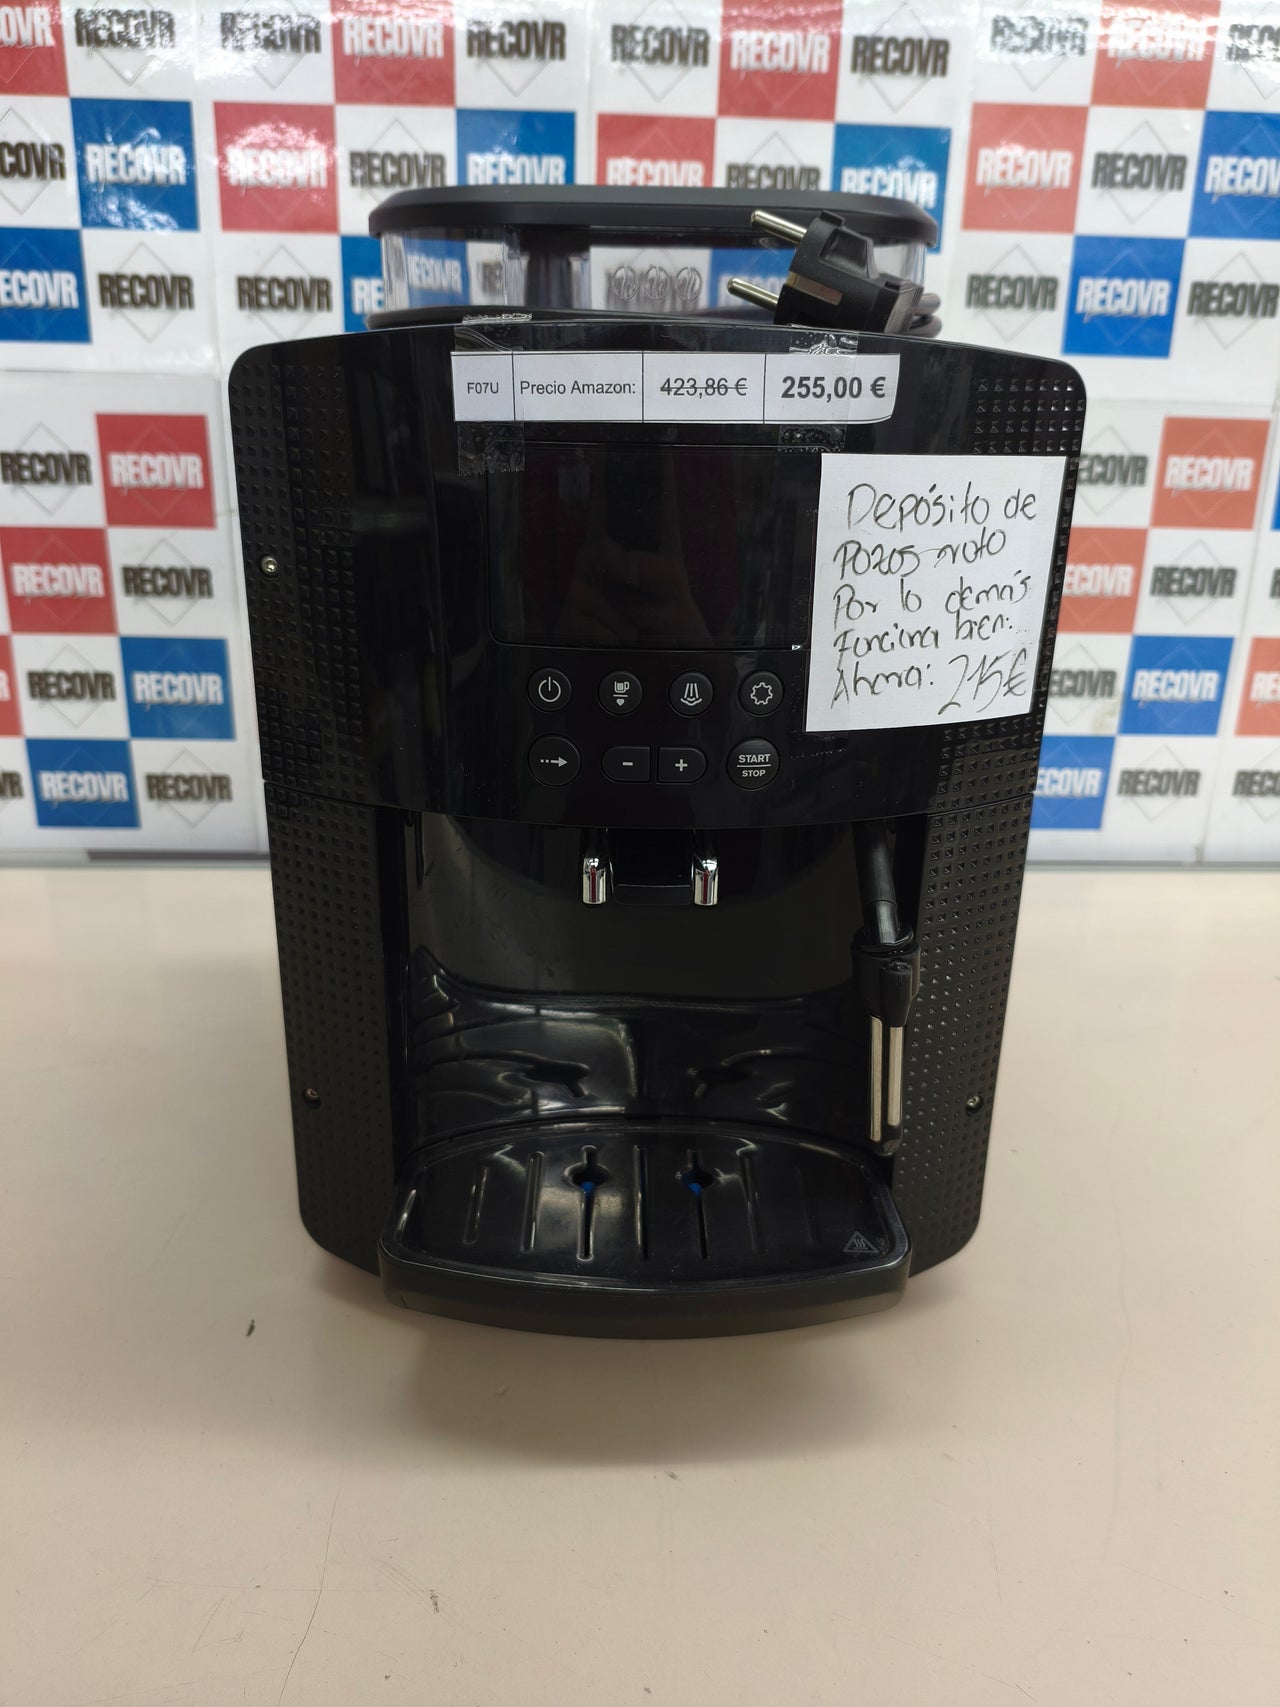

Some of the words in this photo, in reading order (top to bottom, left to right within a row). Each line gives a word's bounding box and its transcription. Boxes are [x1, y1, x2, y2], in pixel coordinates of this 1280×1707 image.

[0, 6, 55, 47] OVR
[344, 18, 444, 58] RECOVR
[467, 20, 566, 61] RECOVR
[611, 25, 710, 67] RECOVR
[731, 31, 829, 73] RECOVR
[851, 36, 949, 77] RECOVR
[86, 144, 187, 184] RECOVR
[351, 152, 447, 187] RECOVR
[468, 154, 566, 184] RECOVR
[975, 149, 1073, 189] RECOVR
[1092, 153, 1188, 191] RECOVR
[98, 273, 195, 311] RECOVR
[237, 276, 333, 312] RECOVR
[966, 274, 1058, 311] RECOVR
[1076, 277, 1171, 316] RECOVR
[1187, 282, 1280, 318] RECOVR
[467, 381, 500, 395] F07U
[520, 380, 566, 396] Precio
[569, 380, 636, 396] Amazon:
[660, 378, 730, 399] 423,86
[735, 378, 748, 397] €
[781, 375, 863, 403] 255,00
[869, 376, 887, 399] €
[0, 452, 92, 485] RECOVR
[108, 453, 203, 489] RECOVR
[1077, 454, 1148, 486] ECOVR
[1164, 456, 1254, 490] RECOVR
[848, 481, 990, 532] Depósito
[1003, 489, 1037, 521] de
[11, 563, 104, 597] RECOVR
[122, 566, 213, 598] RECOVR
[1063, 564, 1134, 597] ECOVR
[1150, 566, 1237, 598] RECOVR
[833, 584, 880, 630] Por
[27, 670, 116, 701] RECOVR
[133, 671, 223, 704] RECOVR
[1050, 669, 1117, 698] ECOVR
[1132, 670, 1219, 701] RECOVR
[738, 753, 771, 764] START
[742, 769, 766, 778] STOP
[39, 771, 129, 802] RECOVR
[146, 772, 233, 802] RECOVR
[1036, 767, 1102, 798] ECOVR
[1117, 769, 1201, 797] RECOVR
